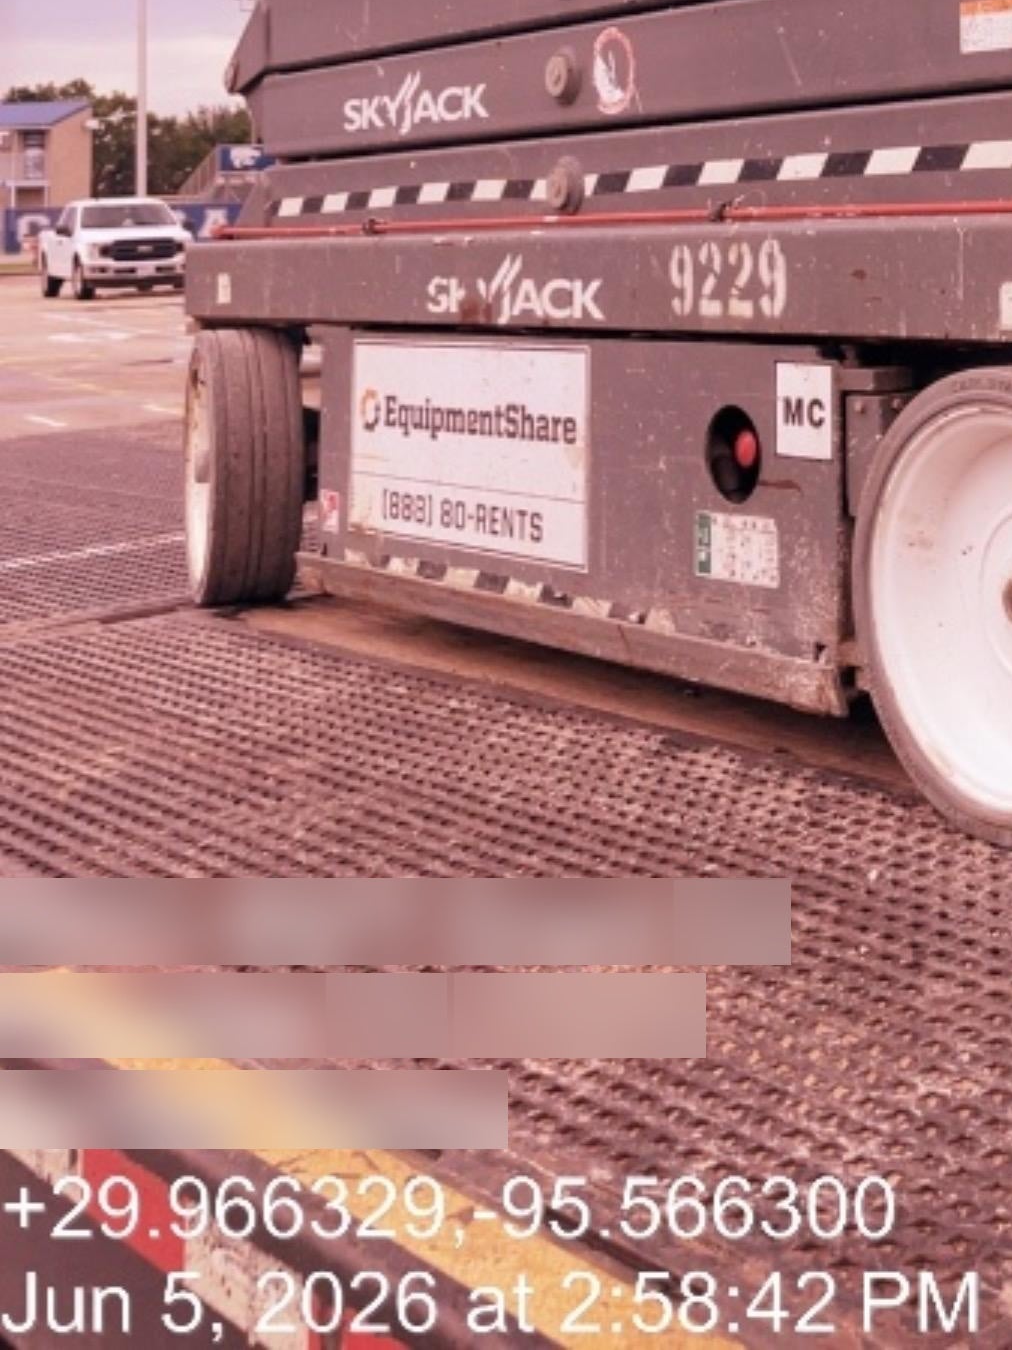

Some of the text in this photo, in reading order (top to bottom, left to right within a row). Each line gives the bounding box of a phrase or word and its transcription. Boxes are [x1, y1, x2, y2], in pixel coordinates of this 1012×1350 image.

[343, 70, 489, 136] SKYJACK
[670, 238, 787, 318] 9229
[383, 395, 577, 445] EquipmentShare
[783, 398, 825, 428] MC
[440, 499, 544, 543] 80-RENTS
